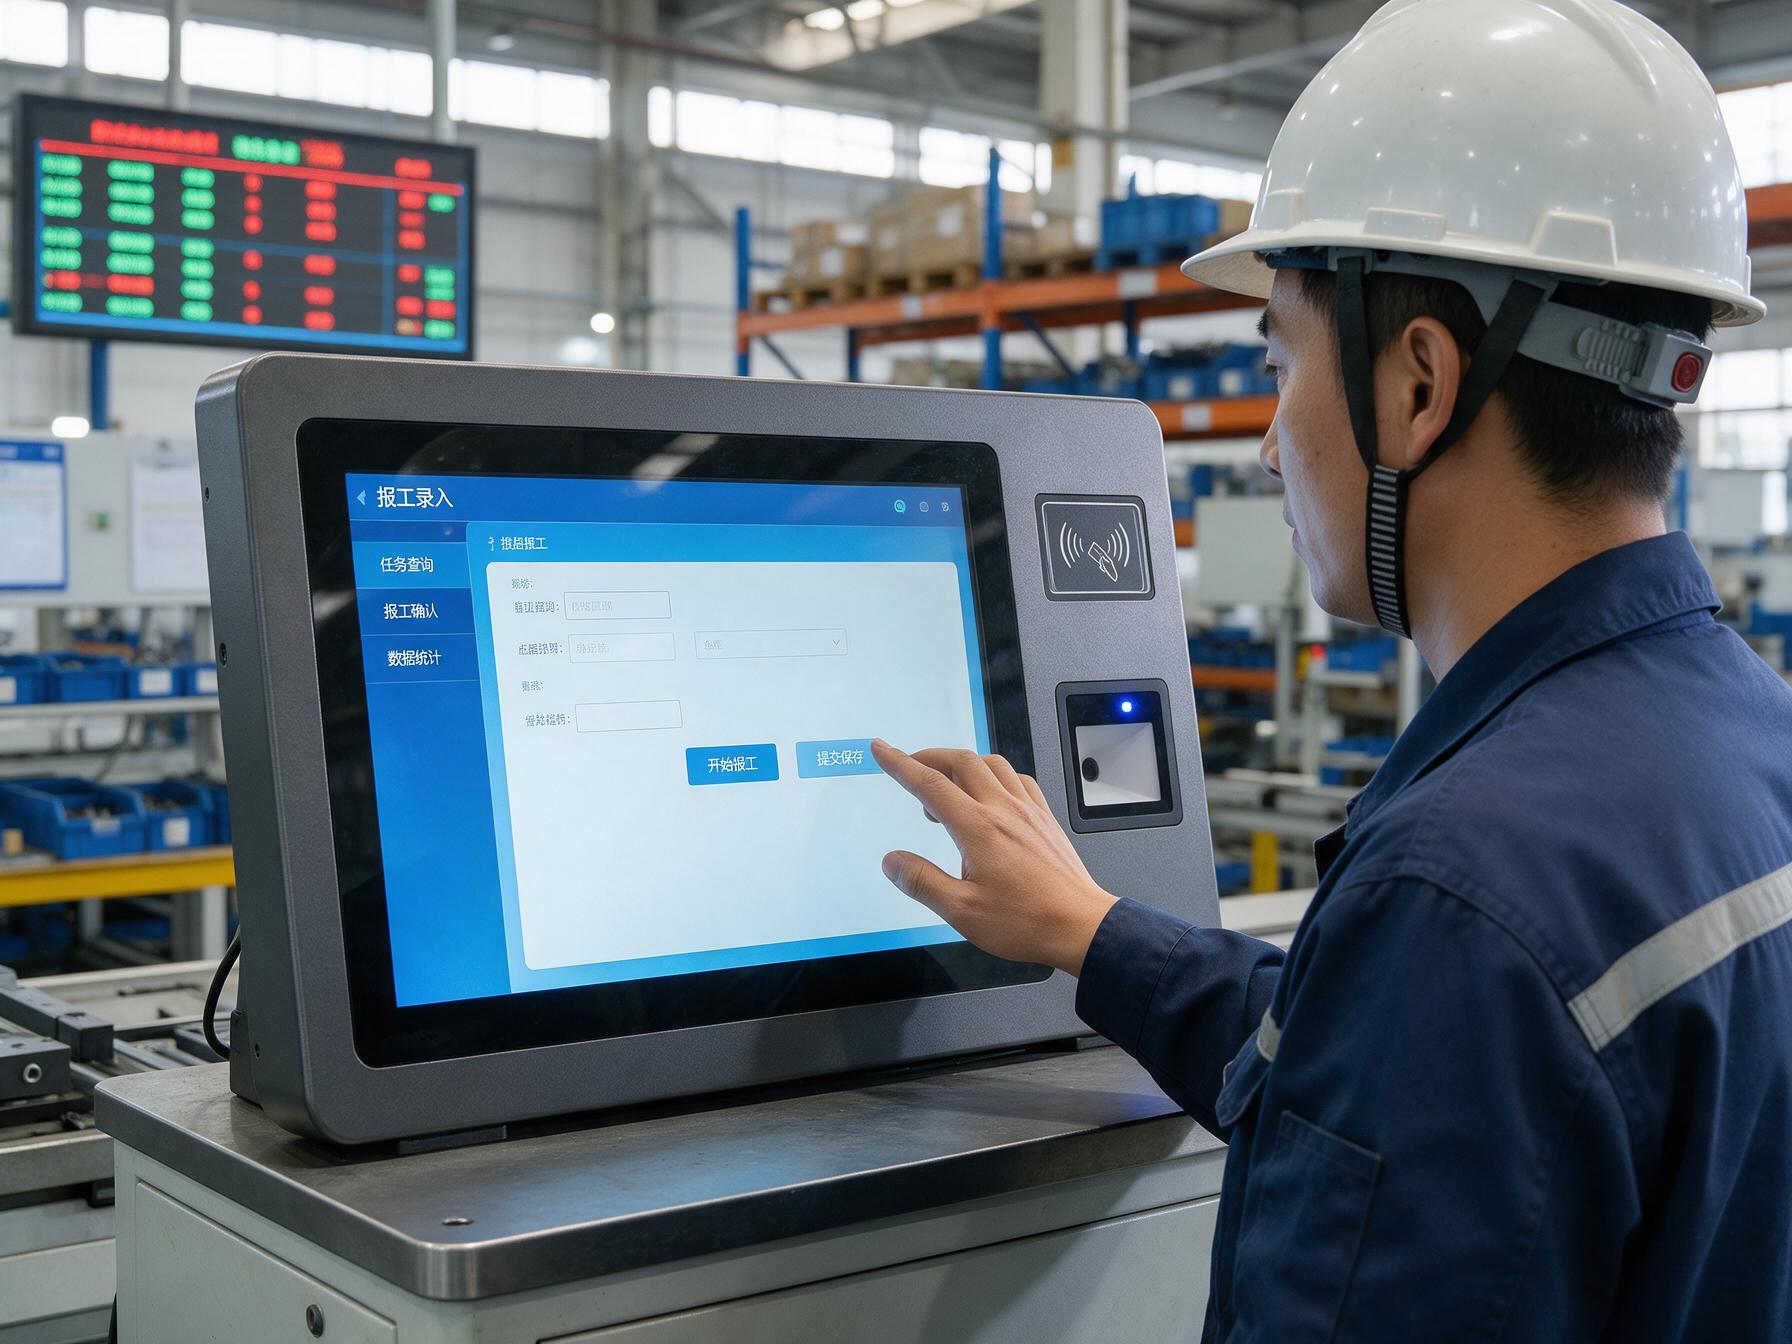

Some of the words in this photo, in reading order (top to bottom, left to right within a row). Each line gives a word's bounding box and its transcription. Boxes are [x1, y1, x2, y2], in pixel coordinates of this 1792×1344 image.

[377, 486, 453, 509] 报工录入
[380, 557, 434, 573] 任务查询
[383, 603, 438, 619] 报工确认
[387, 649, 441, 666] 数据统计
[708, 756, 758, 774] 开始报工
[816, 749, 864, 766] 提交保存
